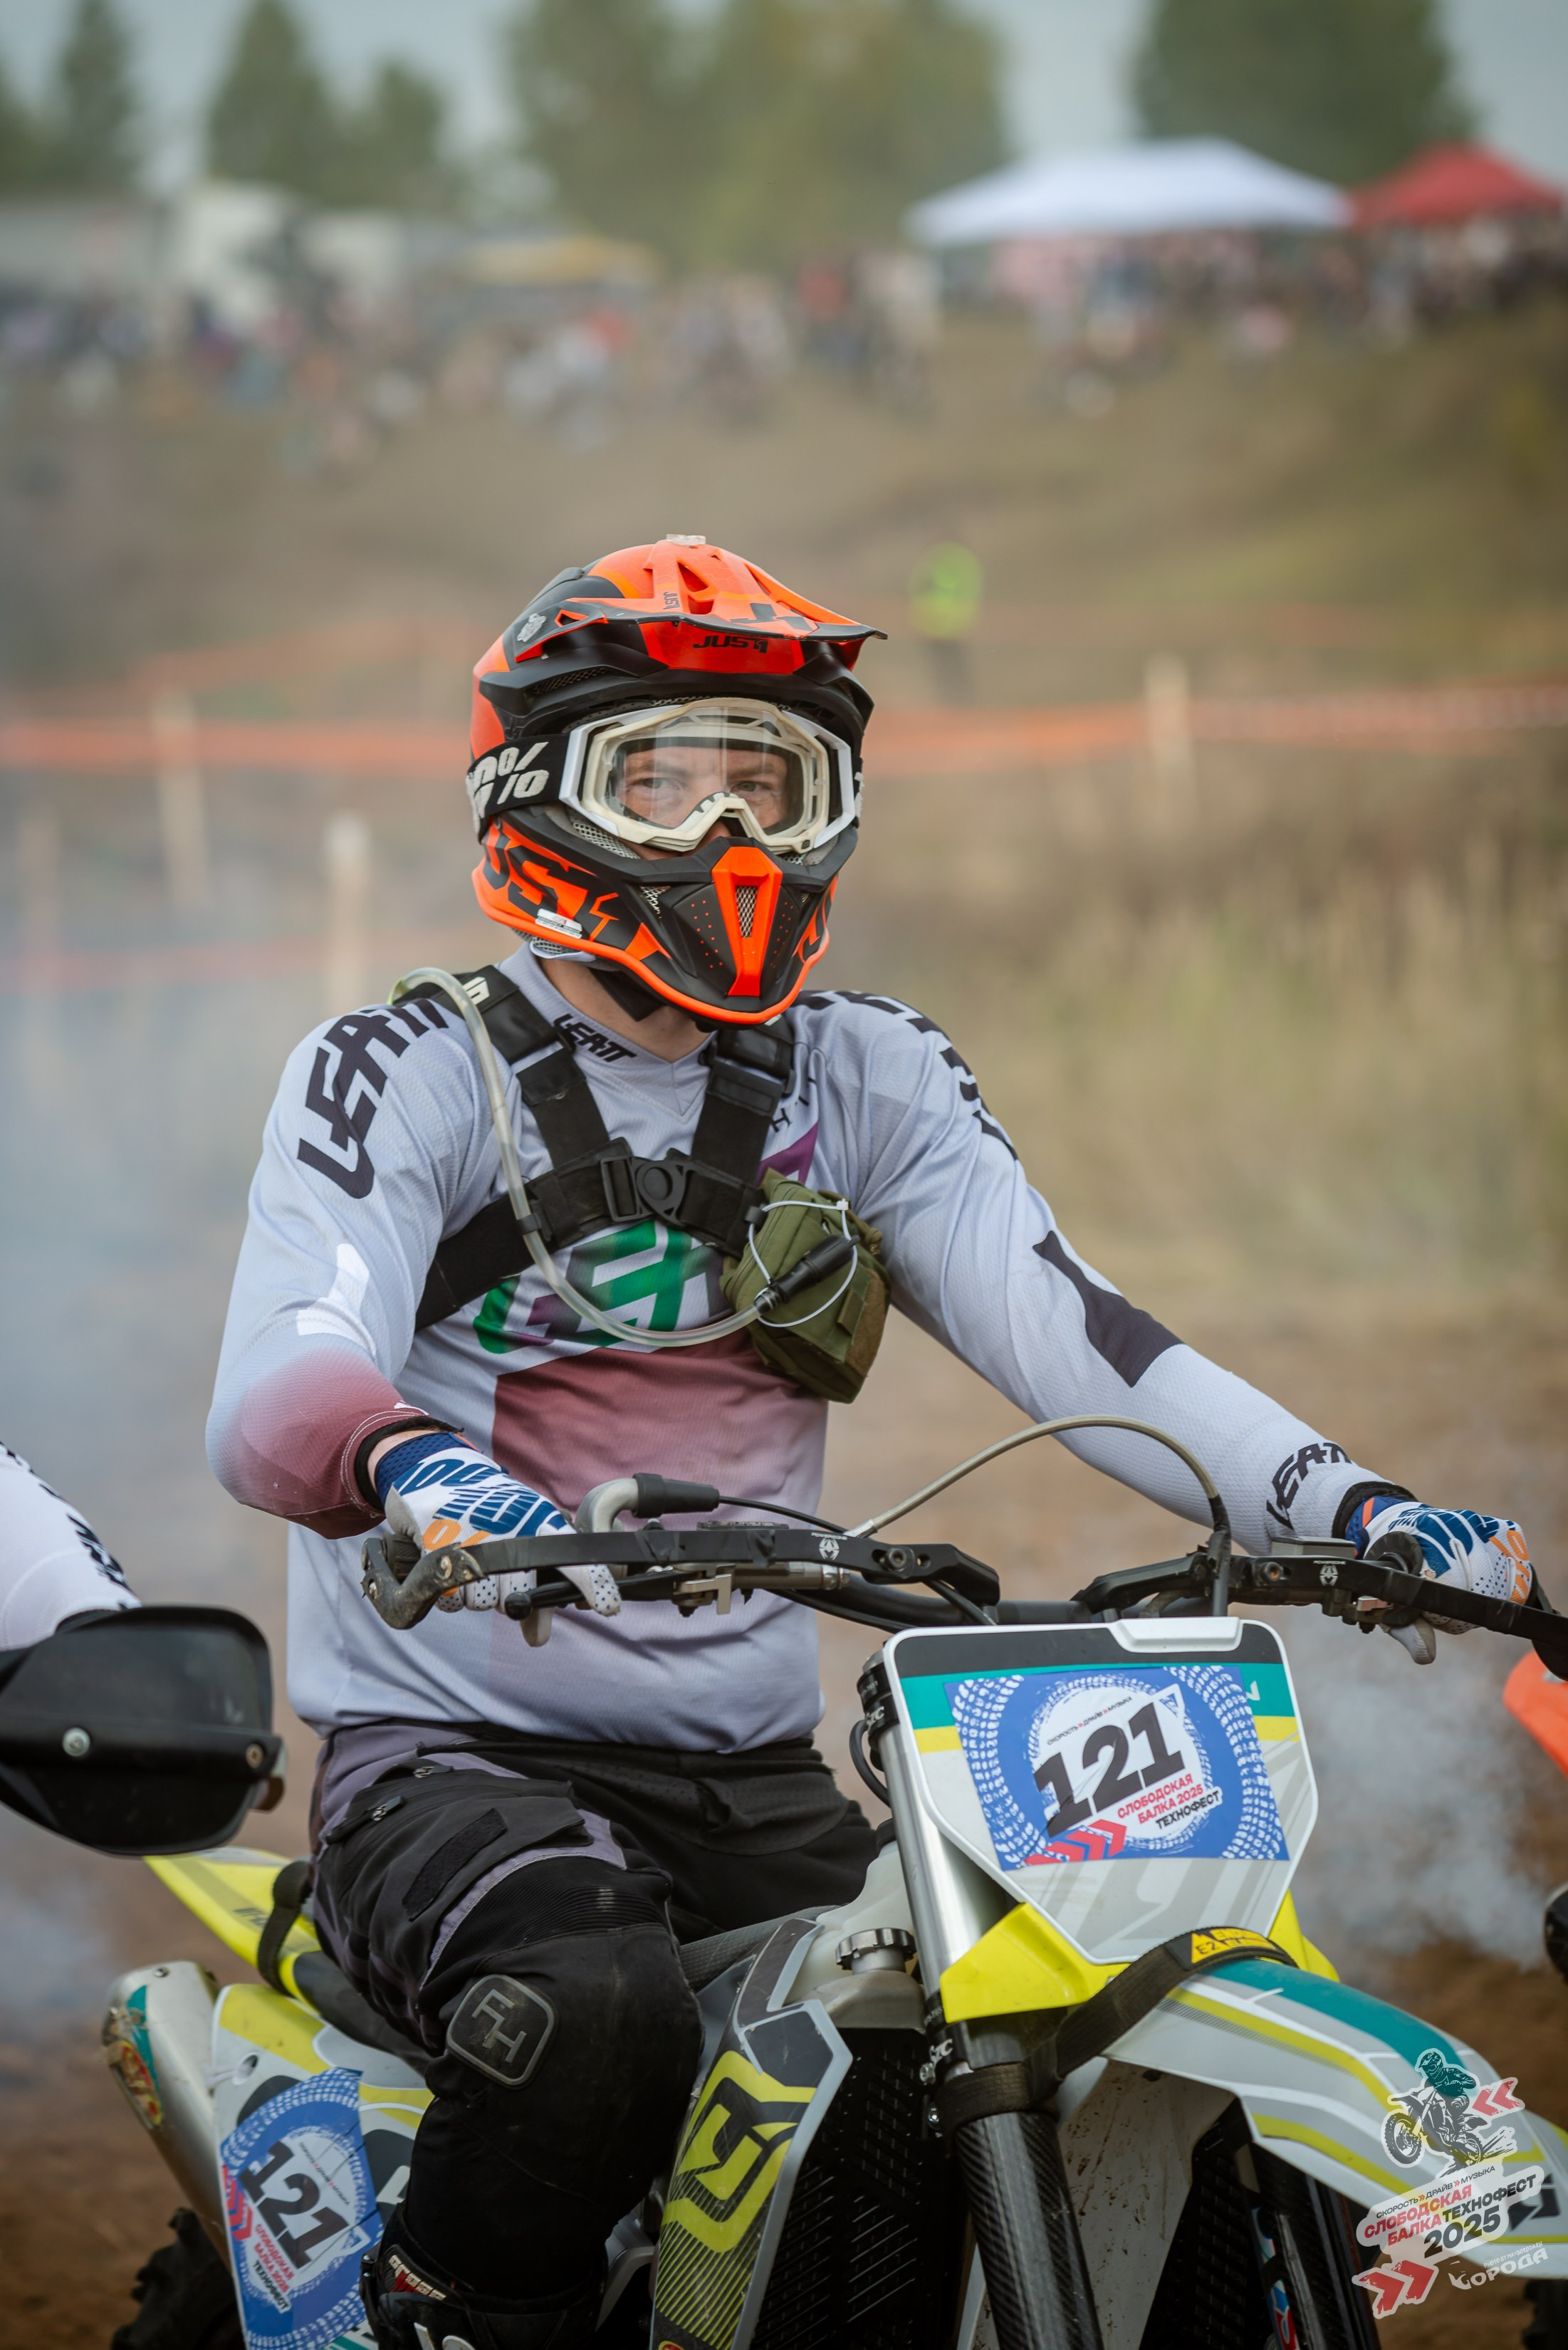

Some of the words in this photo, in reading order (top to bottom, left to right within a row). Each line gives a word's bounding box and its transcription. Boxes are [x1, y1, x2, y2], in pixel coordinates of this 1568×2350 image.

[553, 1013, 637, 1062] LEATT
[1033, 1702, 1185, 1839] 121
[1117, 1773, 1193, 1819] СЛОБОДСКАЯ
[1136, 1798, 1177, 1824] БАЛКА
[1176, 1783, 1204, 1807] 2025
[1155, 1790, 1220, 1830] ТЕХНОФЕСТ
[239, 2141, 350, 2270] 121
